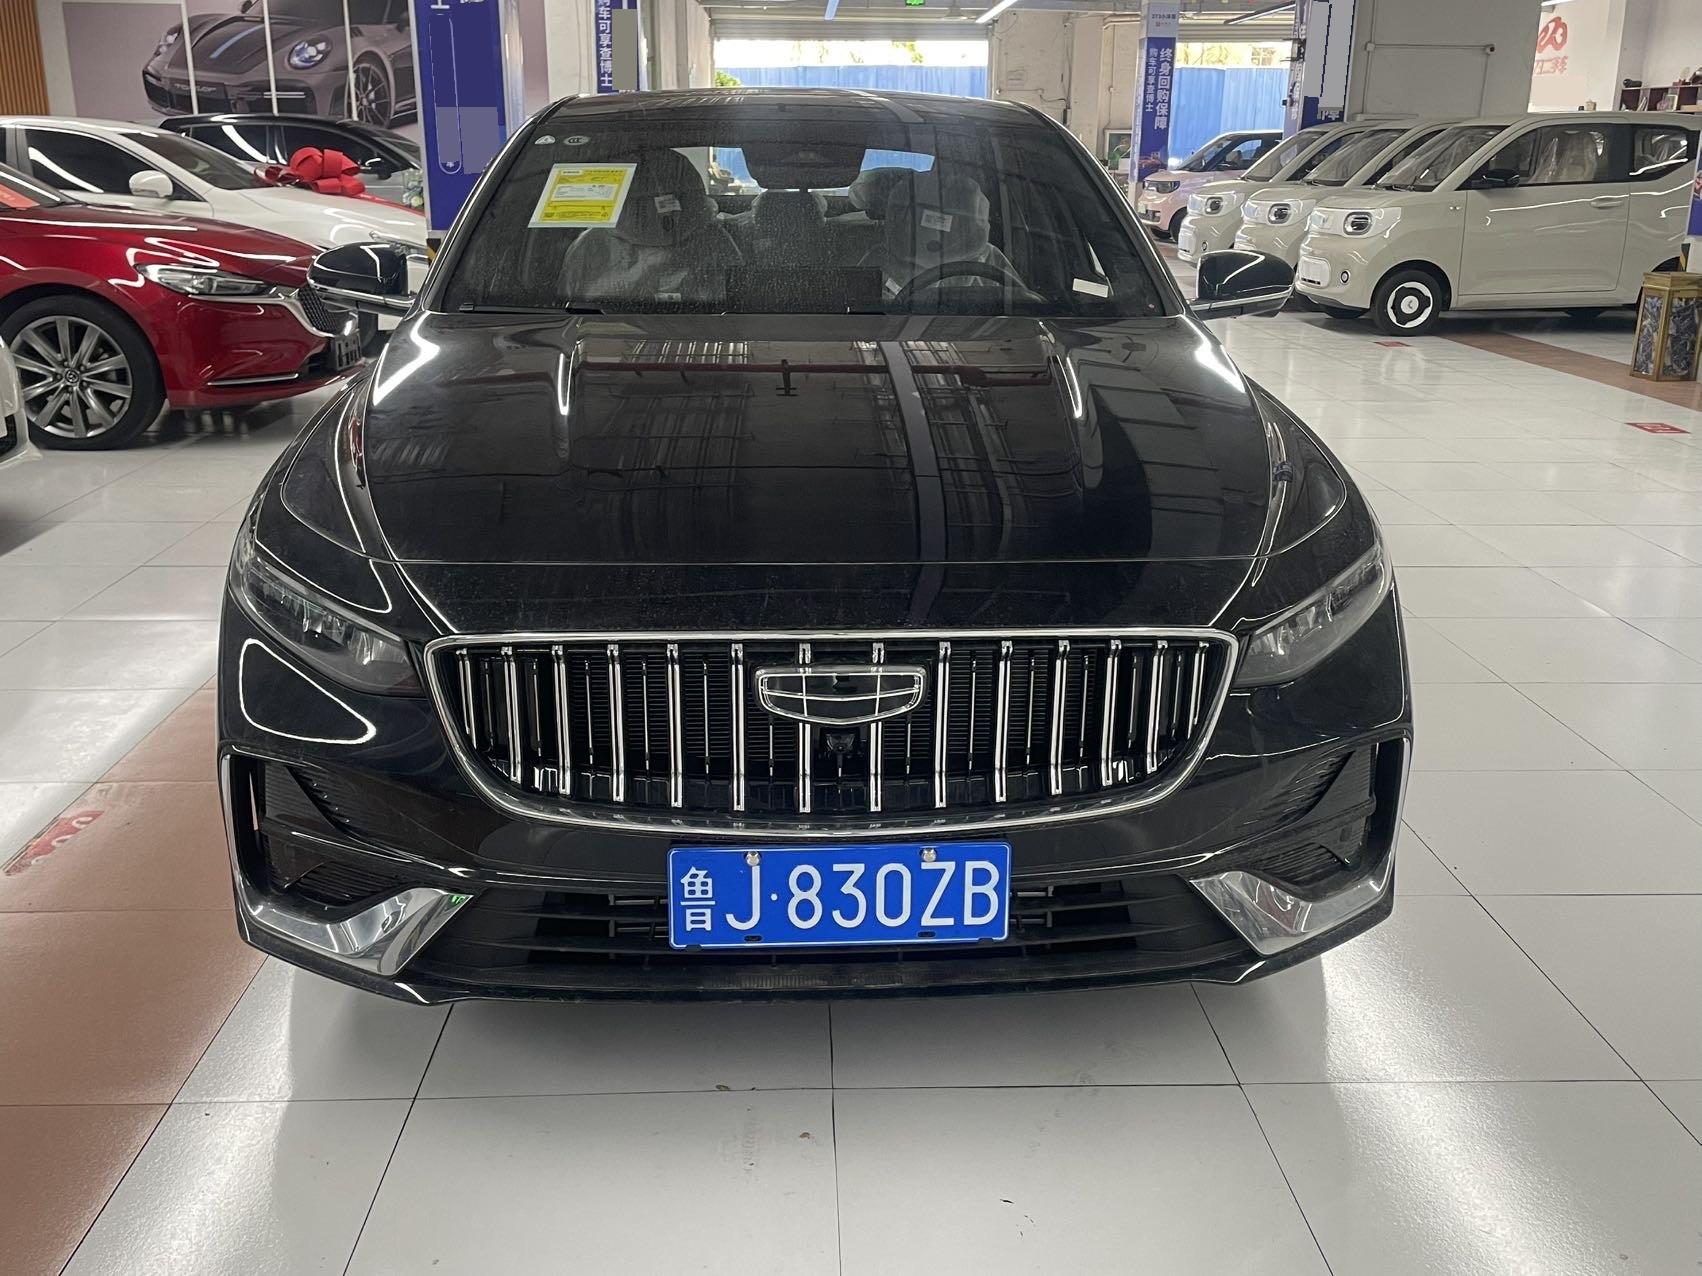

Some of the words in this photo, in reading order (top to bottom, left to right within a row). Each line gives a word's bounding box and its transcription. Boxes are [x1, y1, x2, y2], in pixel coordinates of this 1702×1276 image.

[1154, 48, 1173, 130] 终身回购保障
